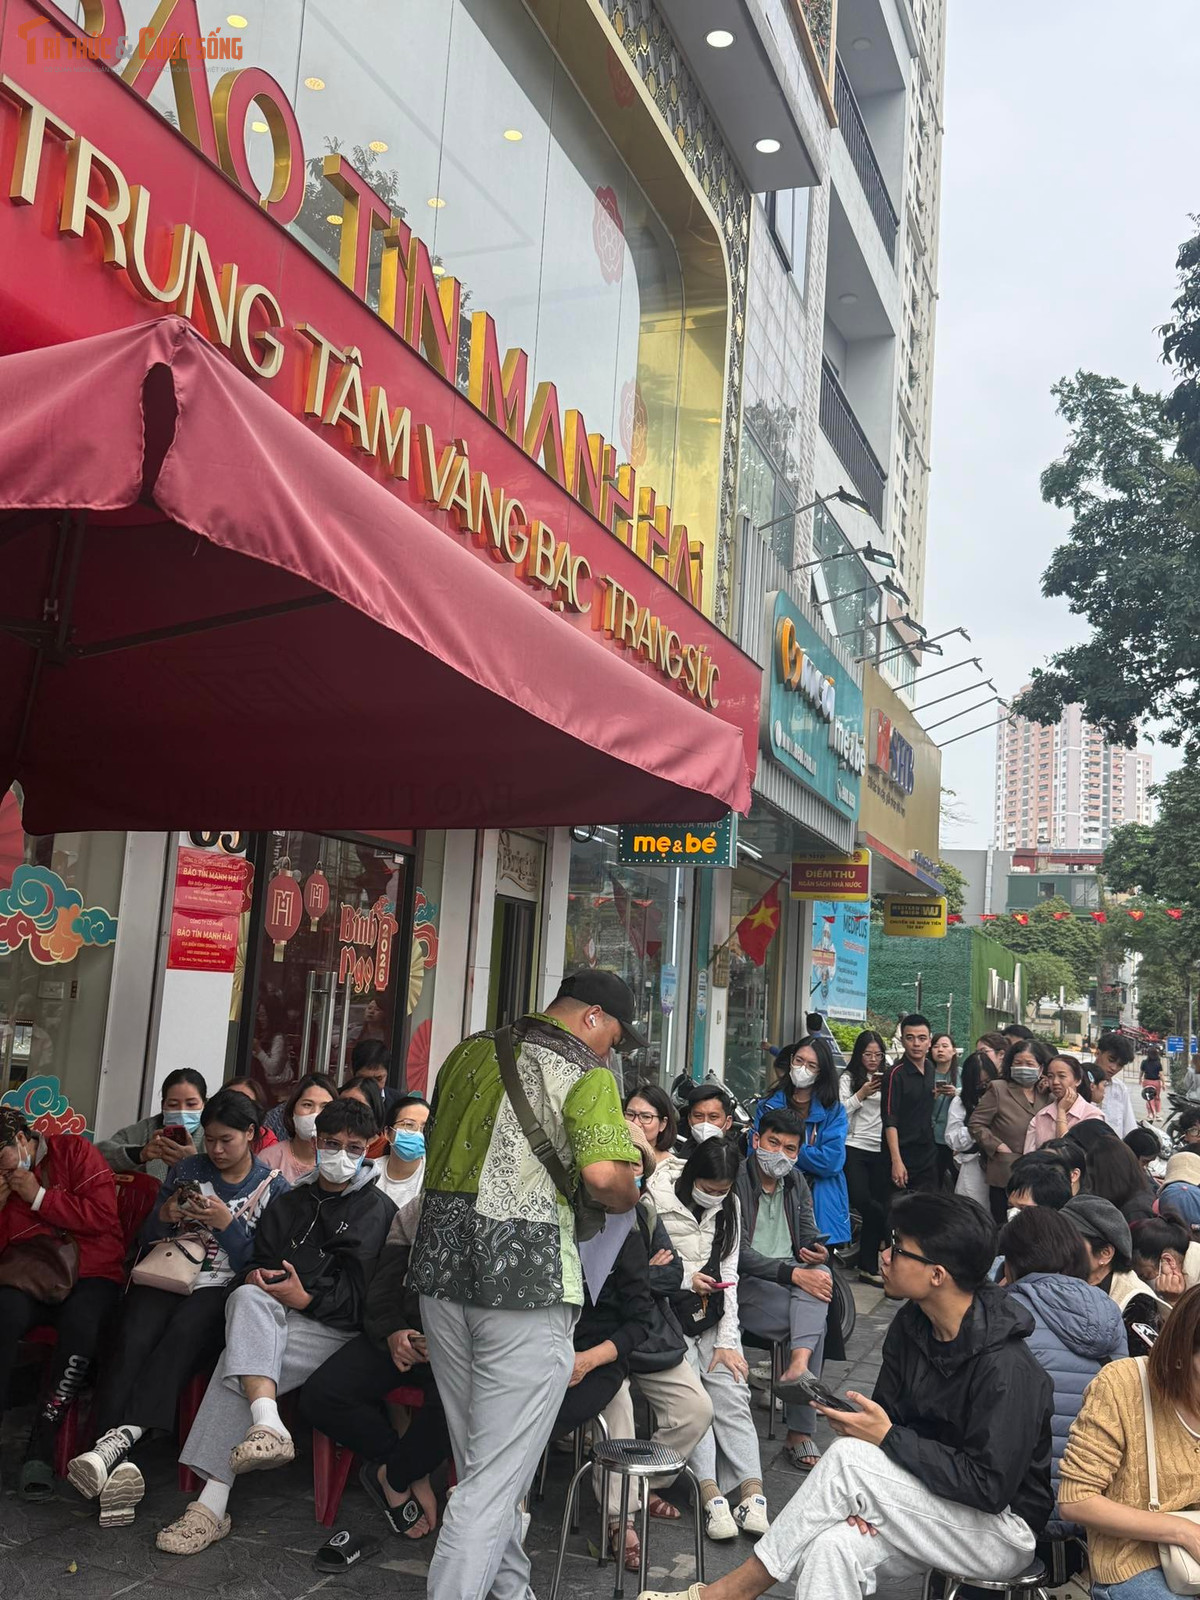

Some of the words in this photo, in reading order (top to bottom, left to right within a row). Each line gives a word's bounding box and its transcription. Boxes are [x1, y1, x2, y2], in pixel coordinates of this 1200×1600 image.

[0, 74, 285, 379] TRUNG
[296, 323, 412, 481] TÂM
[417, 424, 529, 565] VÀNG
[529, 519, 592, 613] BẠC
[600, 575, 683, 679] TRANG
[682, 644, 721, 709] SỨC
[634, 835, 671, 857] mẹ
[672, 840, 683, 853] &
[685, 831, 717, 853] bé
[183, 865, 198, 877] BẢO
[805, 867, 832, 878] ĐIỂM
[834, 870, 856, 879] THU
[844, 880, 862, 888] NƯỚC
[923, 906, 939, 916] WU
[176, 926, 191, 937] BẢO
[192, 928, 202, 938] TÍN
[203, 930, 221, 942] MẠNH
[222, 931, 233, 941] HẢI
[378, 924, 389, 982] 2026
